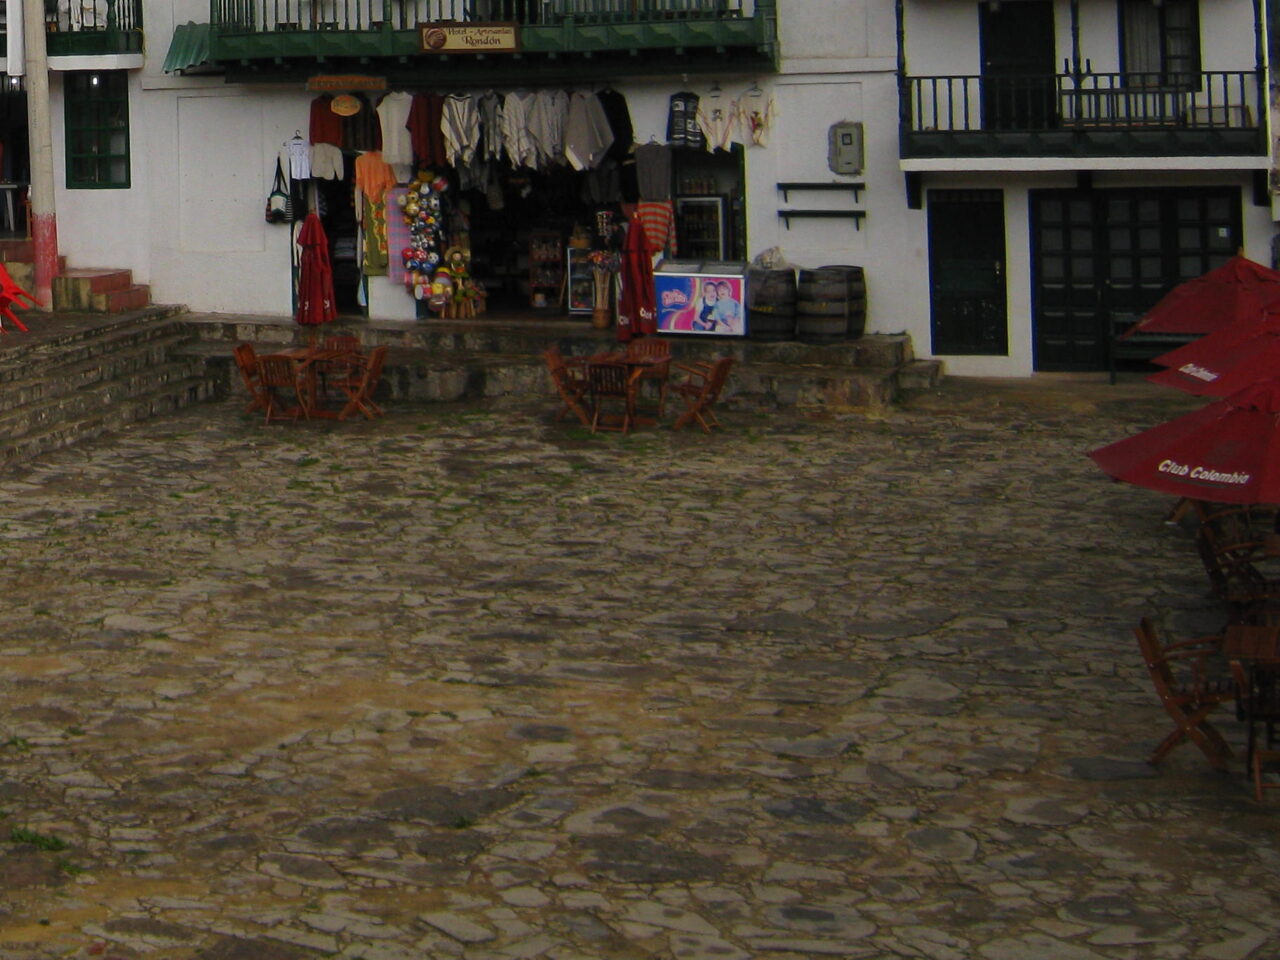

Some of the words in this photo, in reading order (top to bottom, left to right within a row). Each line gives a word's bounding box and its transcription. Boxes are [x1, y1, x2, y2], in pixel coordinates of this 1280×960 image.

[462, 35, 501, 47] Rondón
[1158, 459, 1189, 476] Club
[1190, 466, 1250, 484] Colombia
